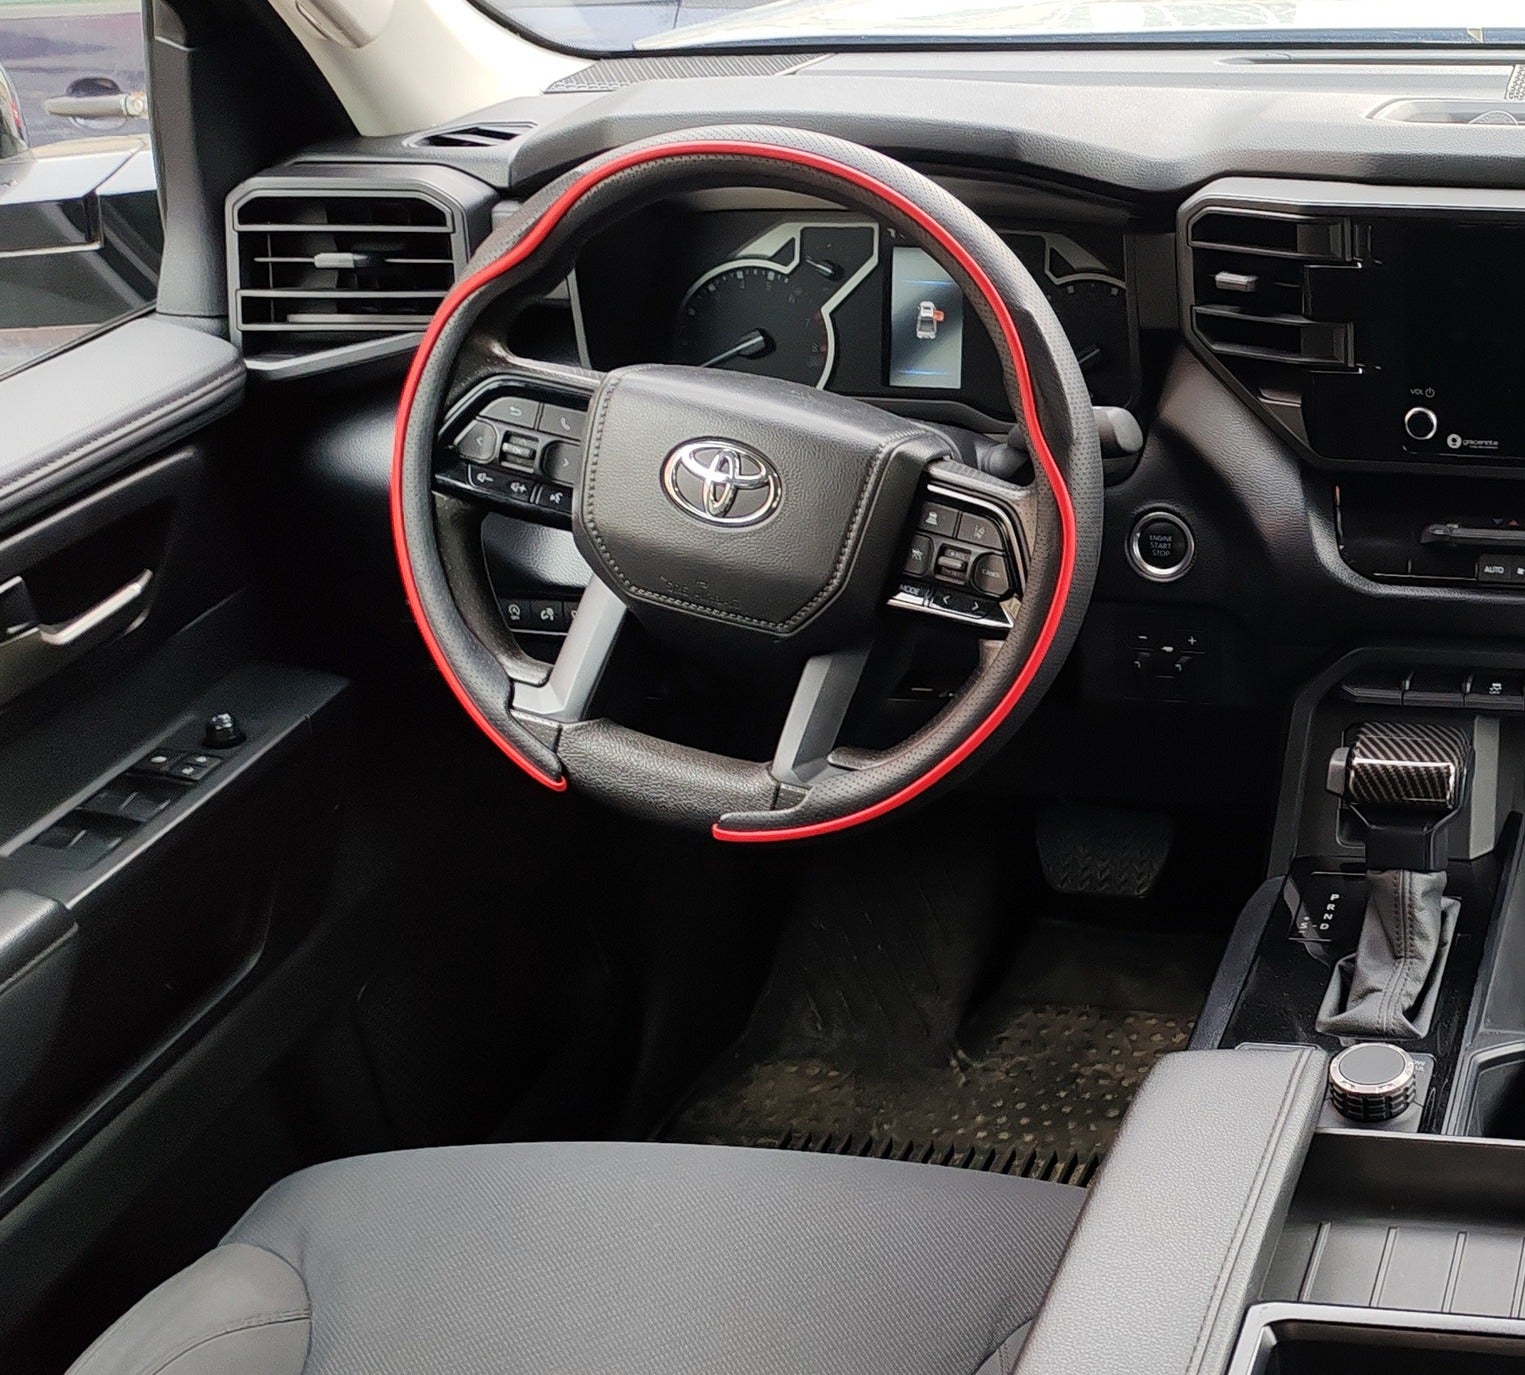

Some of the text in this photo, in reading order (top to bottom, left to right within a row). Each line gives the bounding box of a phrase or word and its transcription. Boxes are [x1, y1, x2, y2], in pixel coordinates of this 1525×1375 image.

[1410, 388, 1424, 396] VOL
[1484, 565, 1504, 574] AUTO
[1330, 893, 1340, 901] P
[1326, 903, 1336, 911] R
